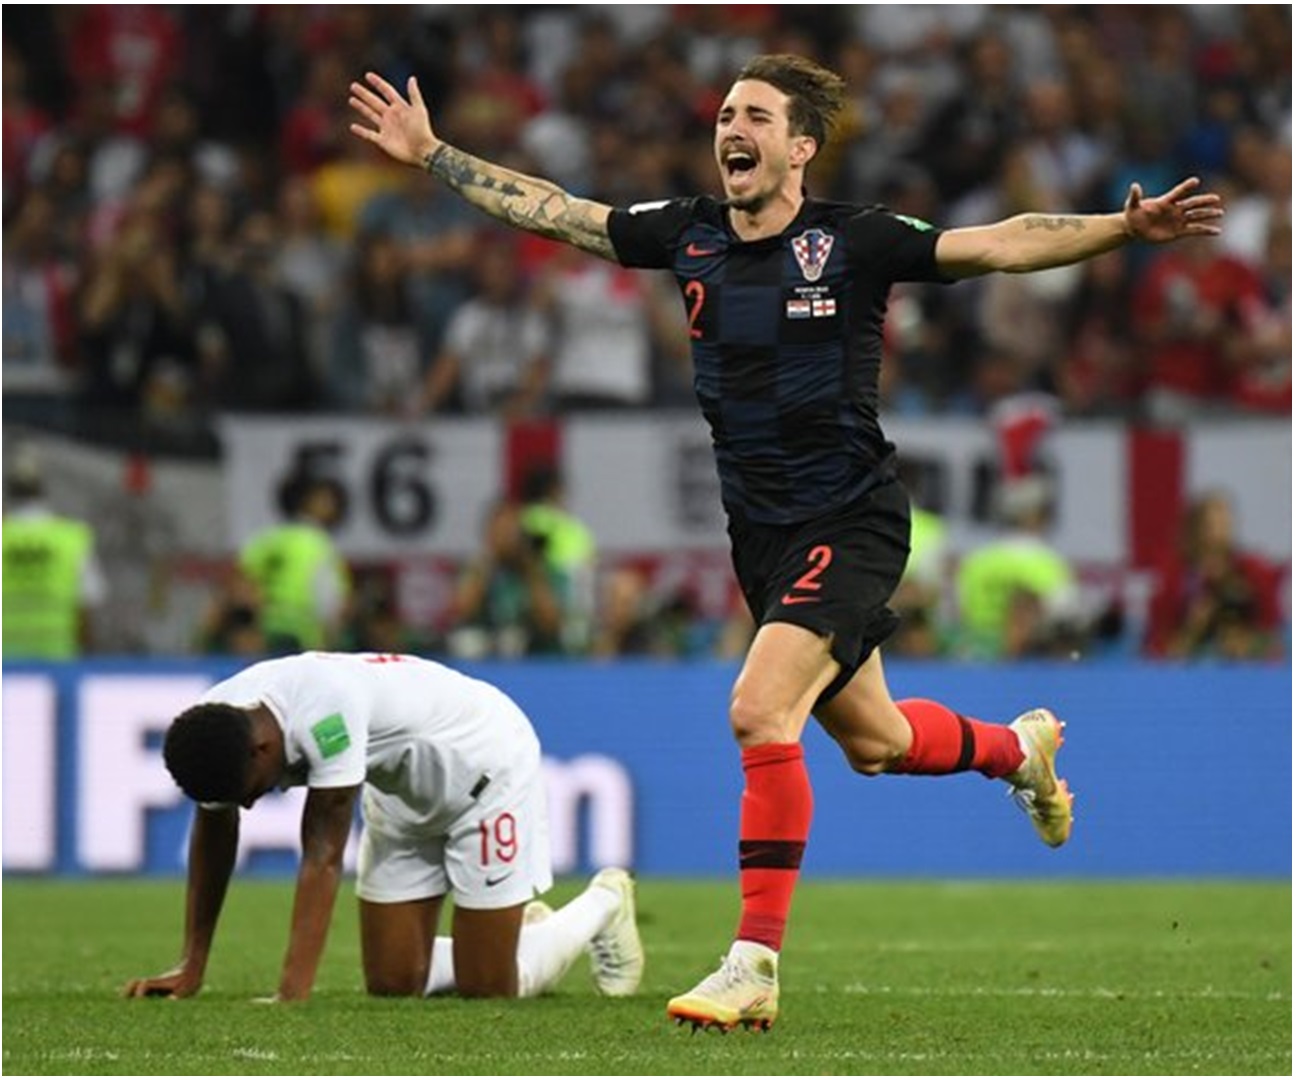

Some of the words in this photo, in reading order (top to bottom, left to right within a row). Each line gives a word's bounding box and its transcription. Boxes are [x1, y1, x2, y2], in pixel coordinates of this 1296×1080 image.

[685, 280, 704, 338] 2
[792, 545, 832, 590] 2
[479, 811, 518, 866] 19
